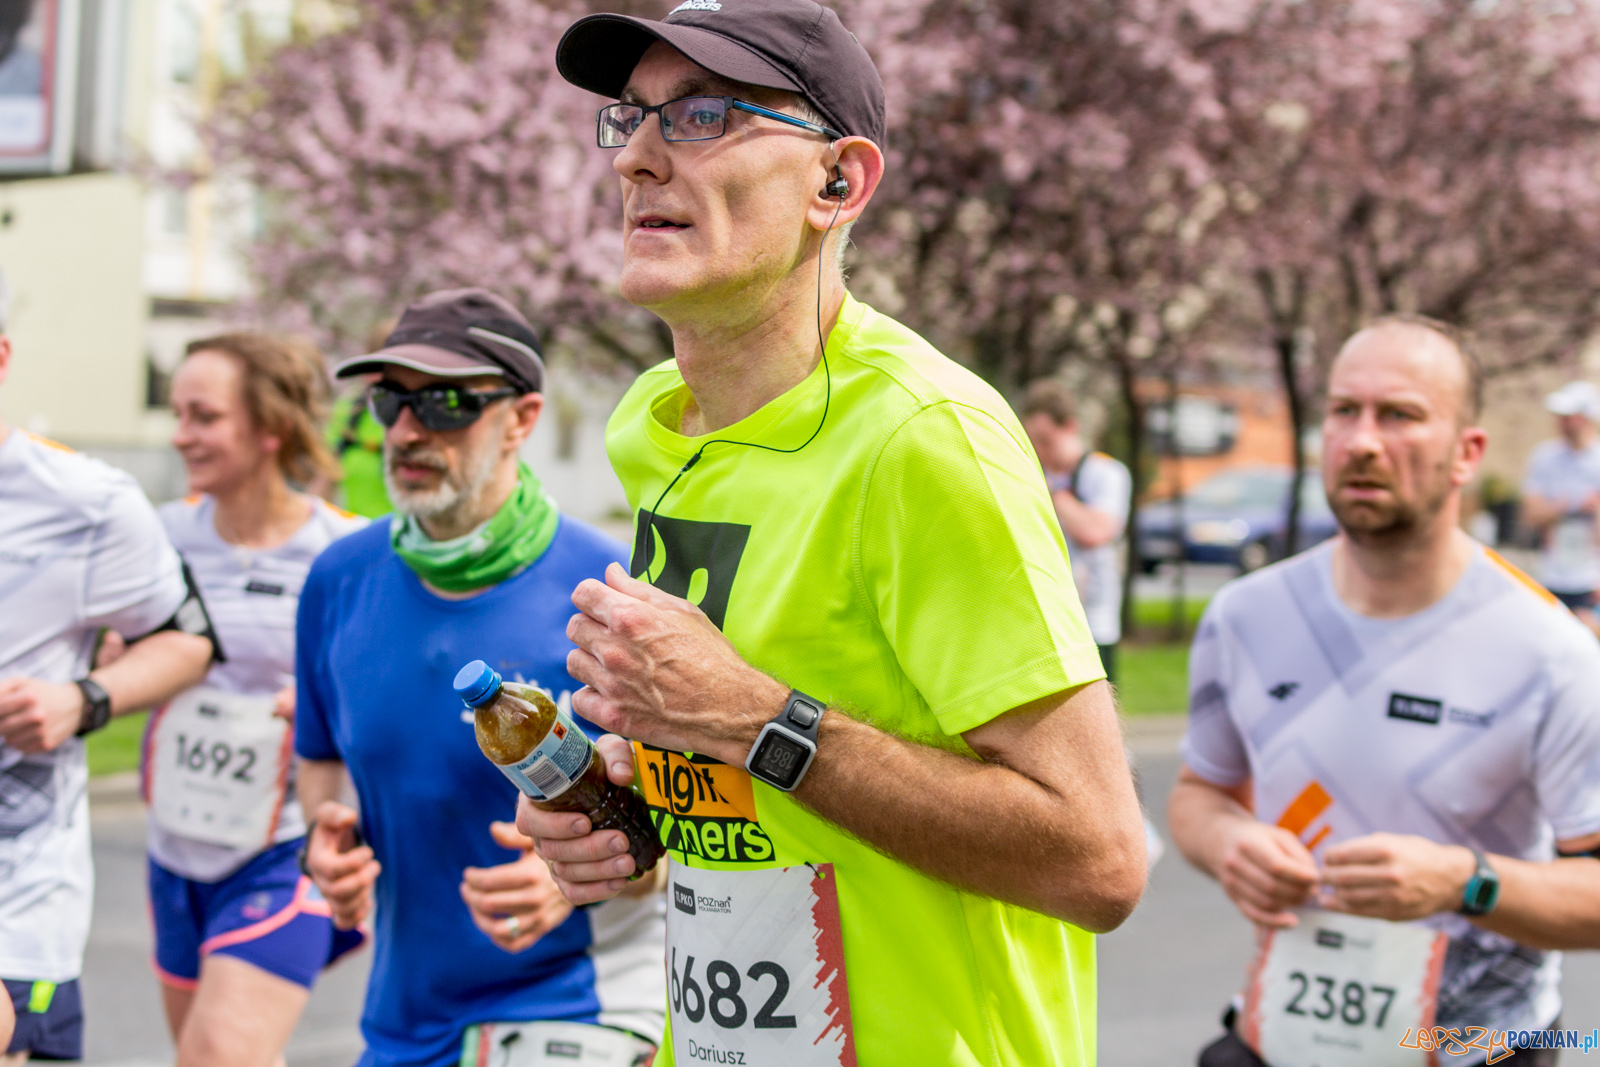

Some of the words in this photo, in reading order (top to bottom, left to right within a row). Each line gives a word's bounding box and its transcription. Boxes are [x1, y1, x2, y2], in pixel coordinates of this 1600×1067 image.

[176, 732, 257, 784] 1692
[671, 946, 797, 1029] 6682
[1284, 970, 1398, 1029] 2387
[688, 1038, 747, 1065] Dariusz
